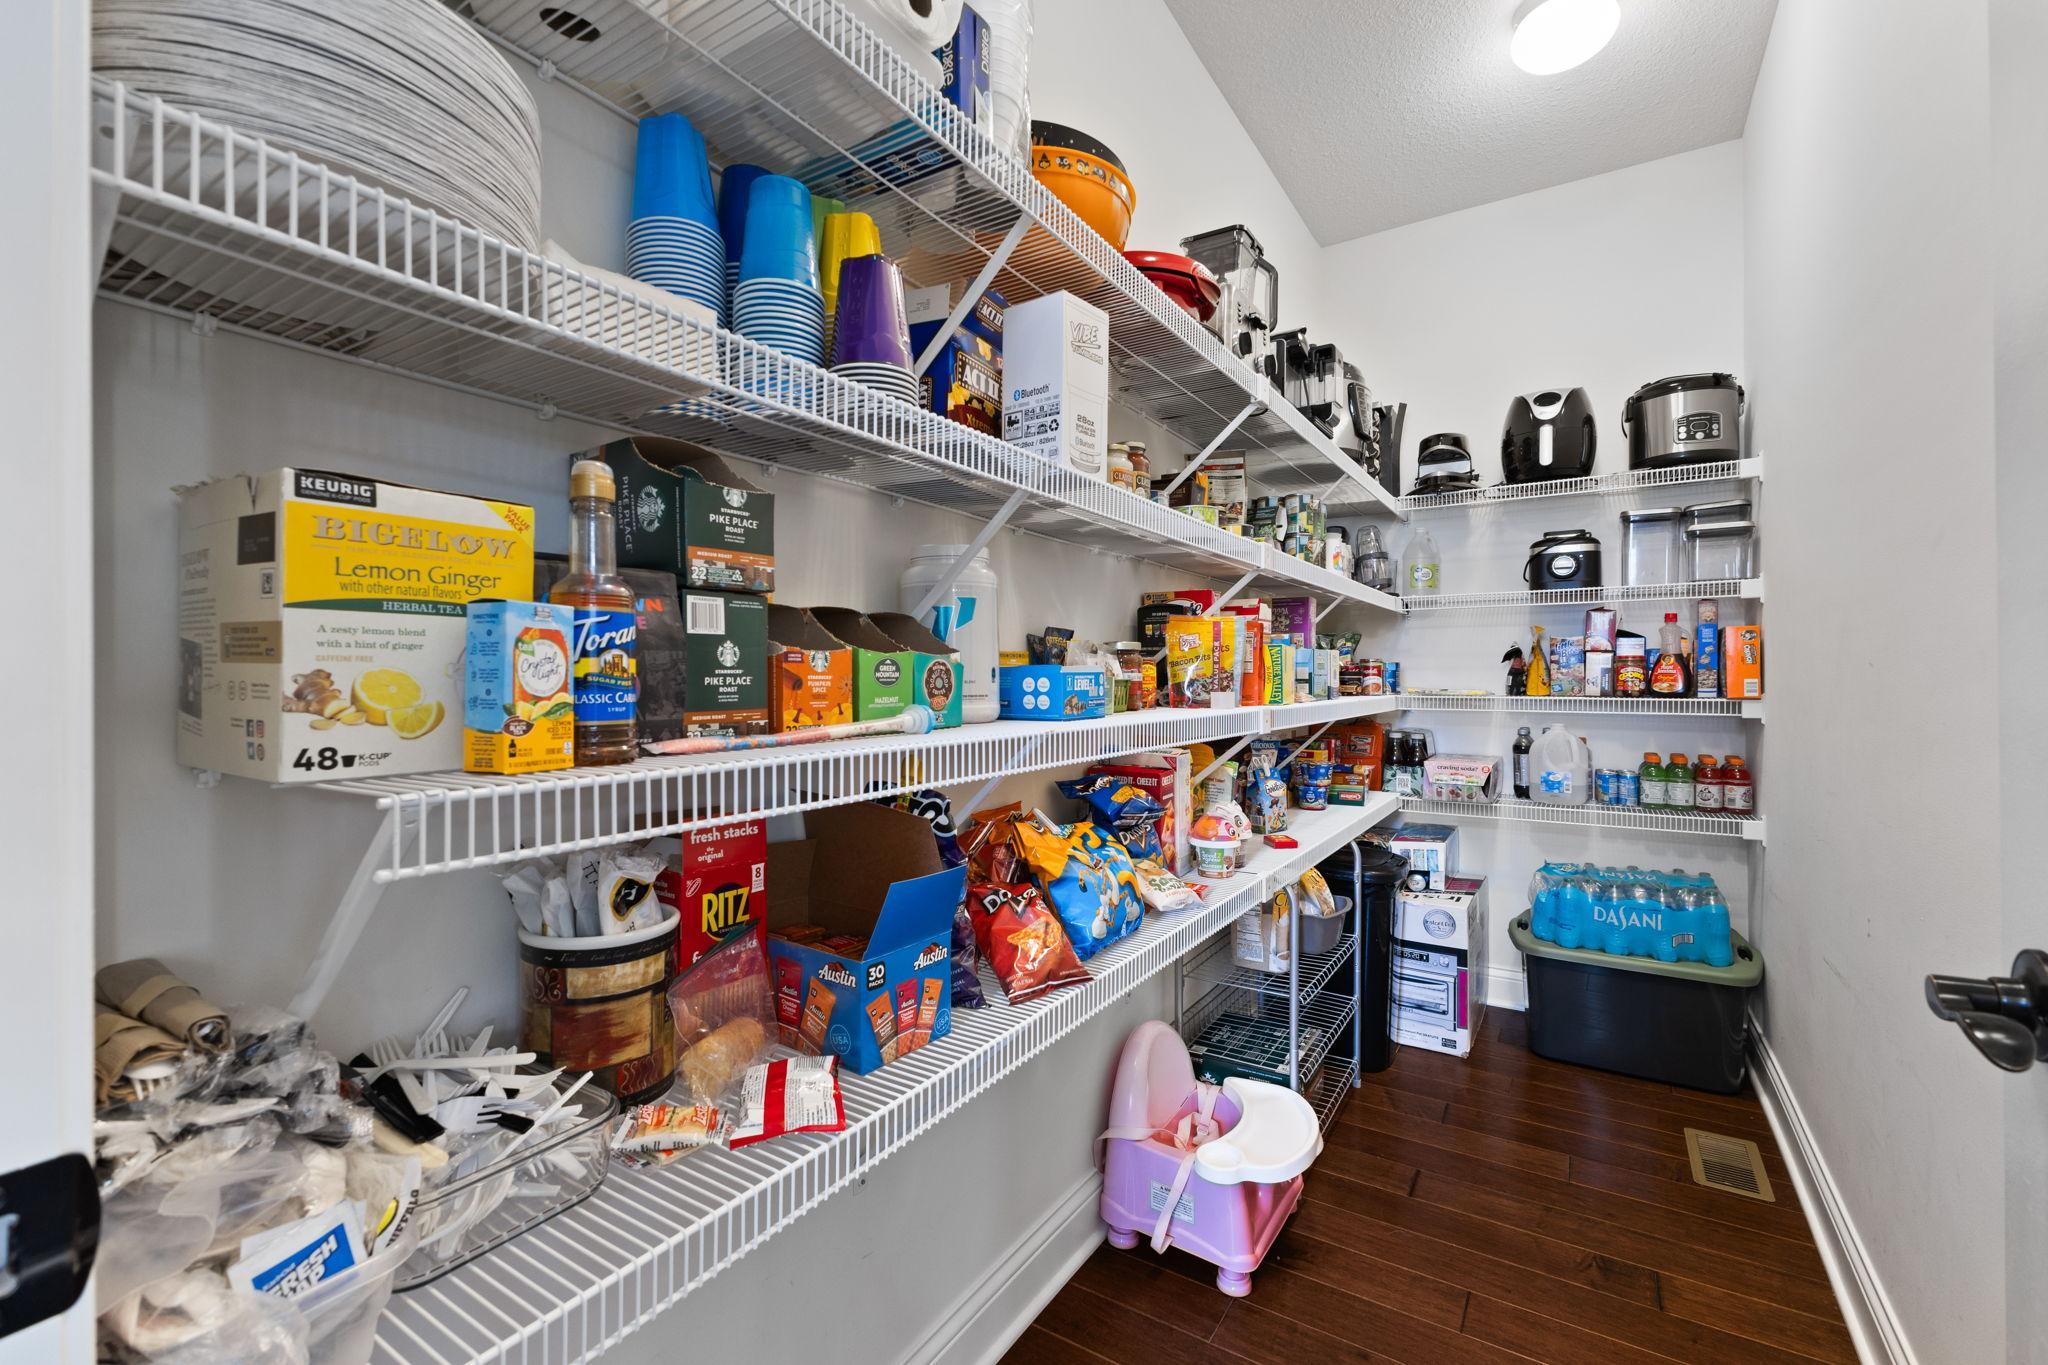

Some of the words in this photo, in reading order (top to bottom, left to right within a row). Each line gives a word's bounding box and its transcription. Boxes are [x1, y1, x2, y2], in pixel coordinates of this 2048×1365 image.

[963, 364, 987, 392] ACT
[1021, 384, 1050, 399] Bluetooth
[300, 476, 372, 497] KEURIG
[622, 475, 630, 506] PIKE
[623, 509, 633, 551] PLACE
[709, 513, 731, 525] PIKE
[732, 516, 758, 529] PLACE
[725, 526, 745, 534] ROAST
[312, 515, 516, 560] BIGELOW
[335, 556, 421, 583] Lemon
[428, 566, 501, 597] Ginger
[691, 566, 707, 580] 22
[340, 581, 364, 593] with
[366, 582, 393, 595] other
[396, 585, 430, 598] natural
[433, 587, 462, 600] flavors
[382, 601, 436, 613] HERBAL
[438, 604, 463, 615] TEA
[316, 624, 327, 633] A
[330, 626, 357, 637] zesty
[361, 626, 396, 636] lemon
[398, 627, 427, 637] blend
[316, 640, 342, 649] with
[344, 641, 352, 649] a
[354, 640, 378, 650] hint
[380, 641, 390, 650] of
[392, 642, 425, 652] ginger
[1213, 641, 1221, 664] PACK
[520, 651, 558, 678] Crystal
[1269, 646, 1283, 675] NATURE
[586, 675, 616, 685] SUGAR
[617, 679, 632, 687] FREE
[704, 677, 724, 686] PIKE
[725, 676, 752, 685] PLACE
[1213, 665, 1221, 690] VALUE
[574, 693, 613, 704] LASSIC
[1270, 674, 1283, 704] VALLEY
[293, 746, 339, 771] 48
[690, 826, 721, 845] fresh
[723, 822, 759, 840] stacks
[697, 849, 724, 863] original
[755, 866, 761, 879] 8
[702, 887, 750, 933] RITZ
[1593, 905, 1663, 932] DASANI
[913, 946, 948, 971] Austin
[818, 964, 857, 988] Austin
[868, 965, 885, 981] 30
[868, 979, 884, 988] PACKS
[832, 1036, 849, 1045] USA
